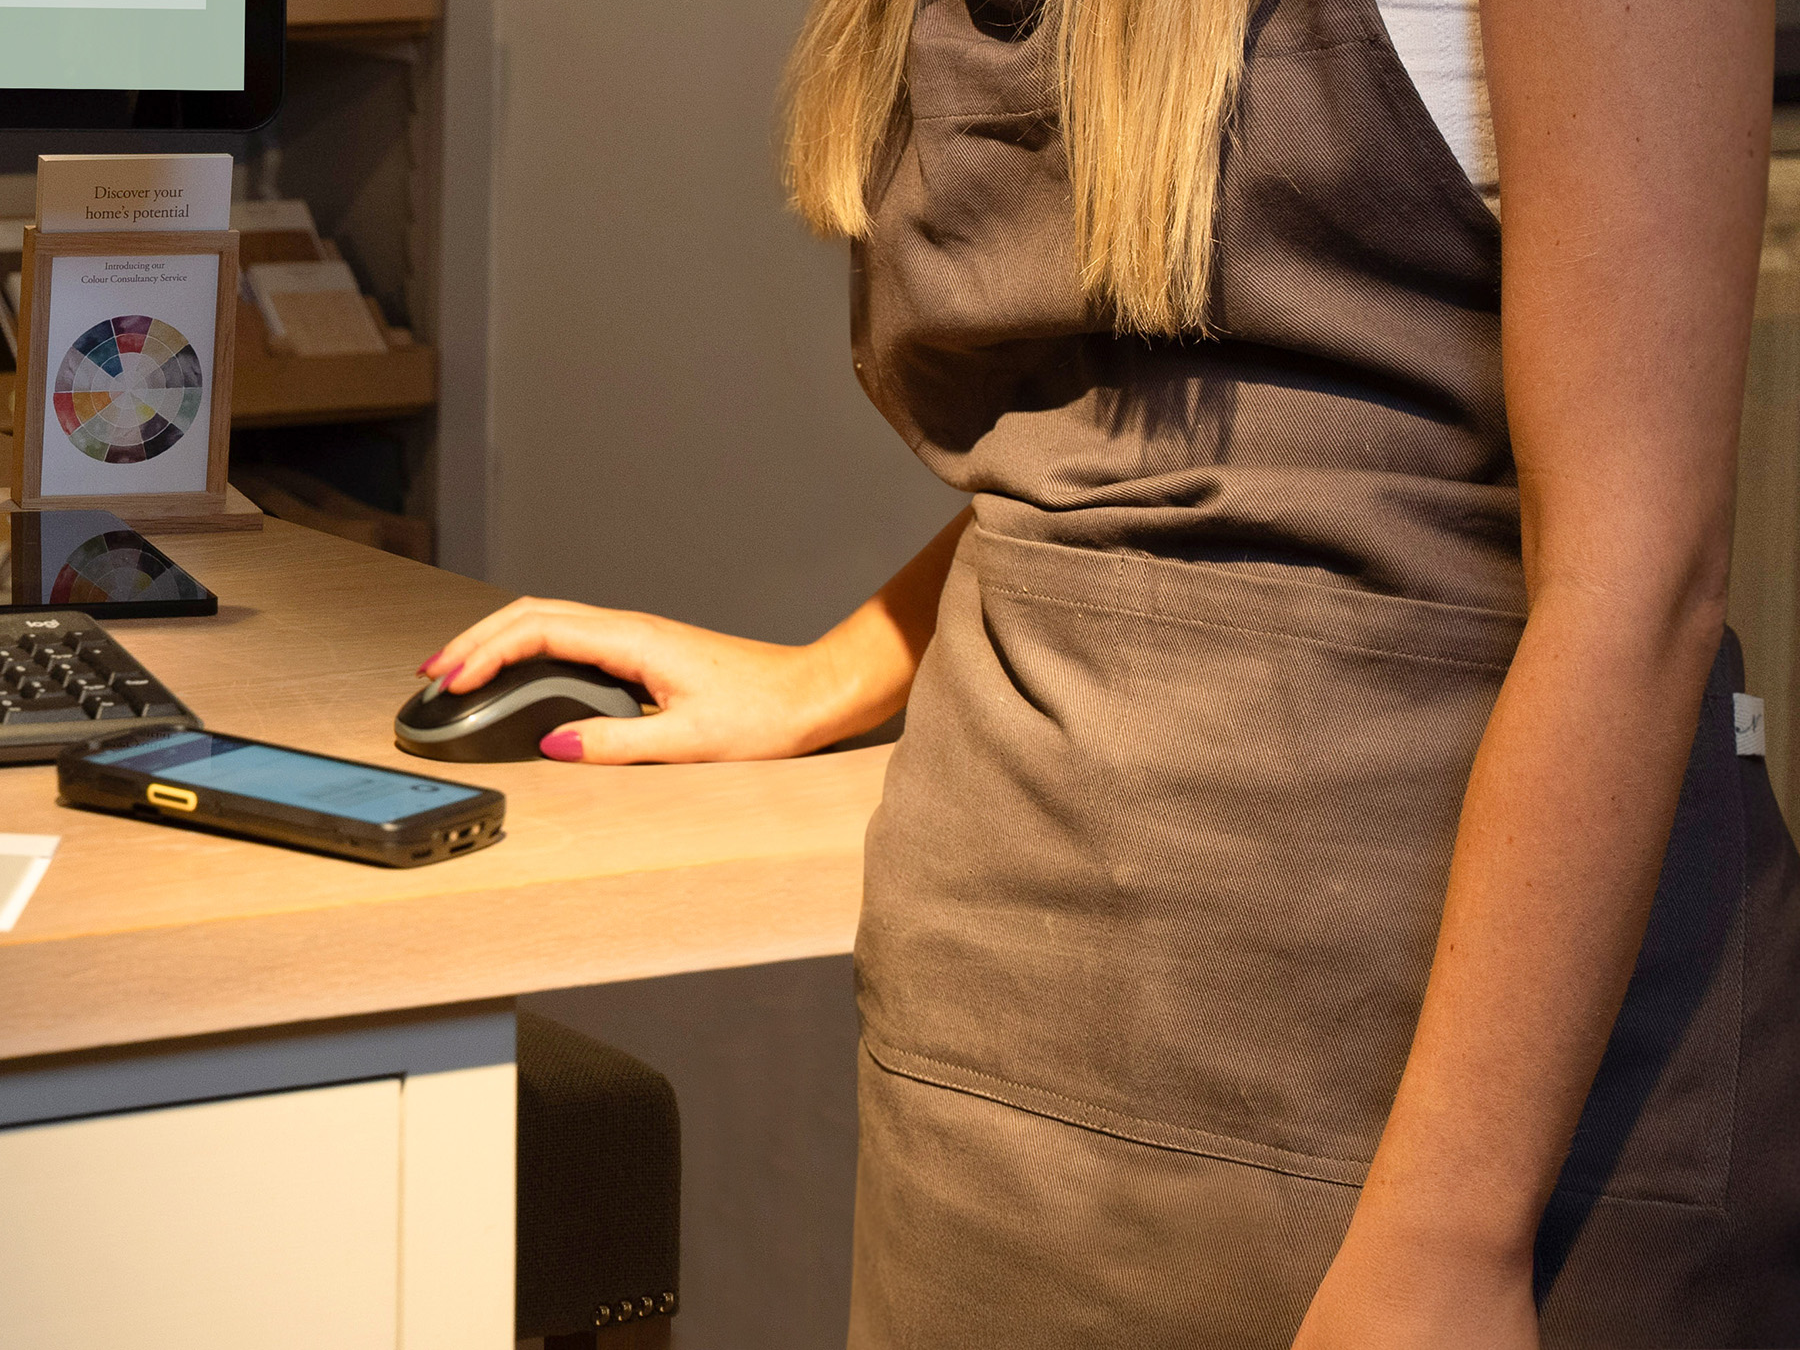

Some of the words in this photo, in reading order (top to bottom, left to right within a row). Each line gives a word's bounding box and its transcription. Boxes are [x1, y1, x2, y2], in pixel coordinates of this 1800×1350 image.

[94, 185, 151, 200] Discover
[153, 189, 184, 203] your
[132, 203, 190, 223] potential
[104, 261, 150, 271] Introducing
[151, 262, 166, 270] our
[80, 274, 109, 284] Colour
[110, 273, 159, 284] Consultancy
[159, 272, 188, 282] Service
